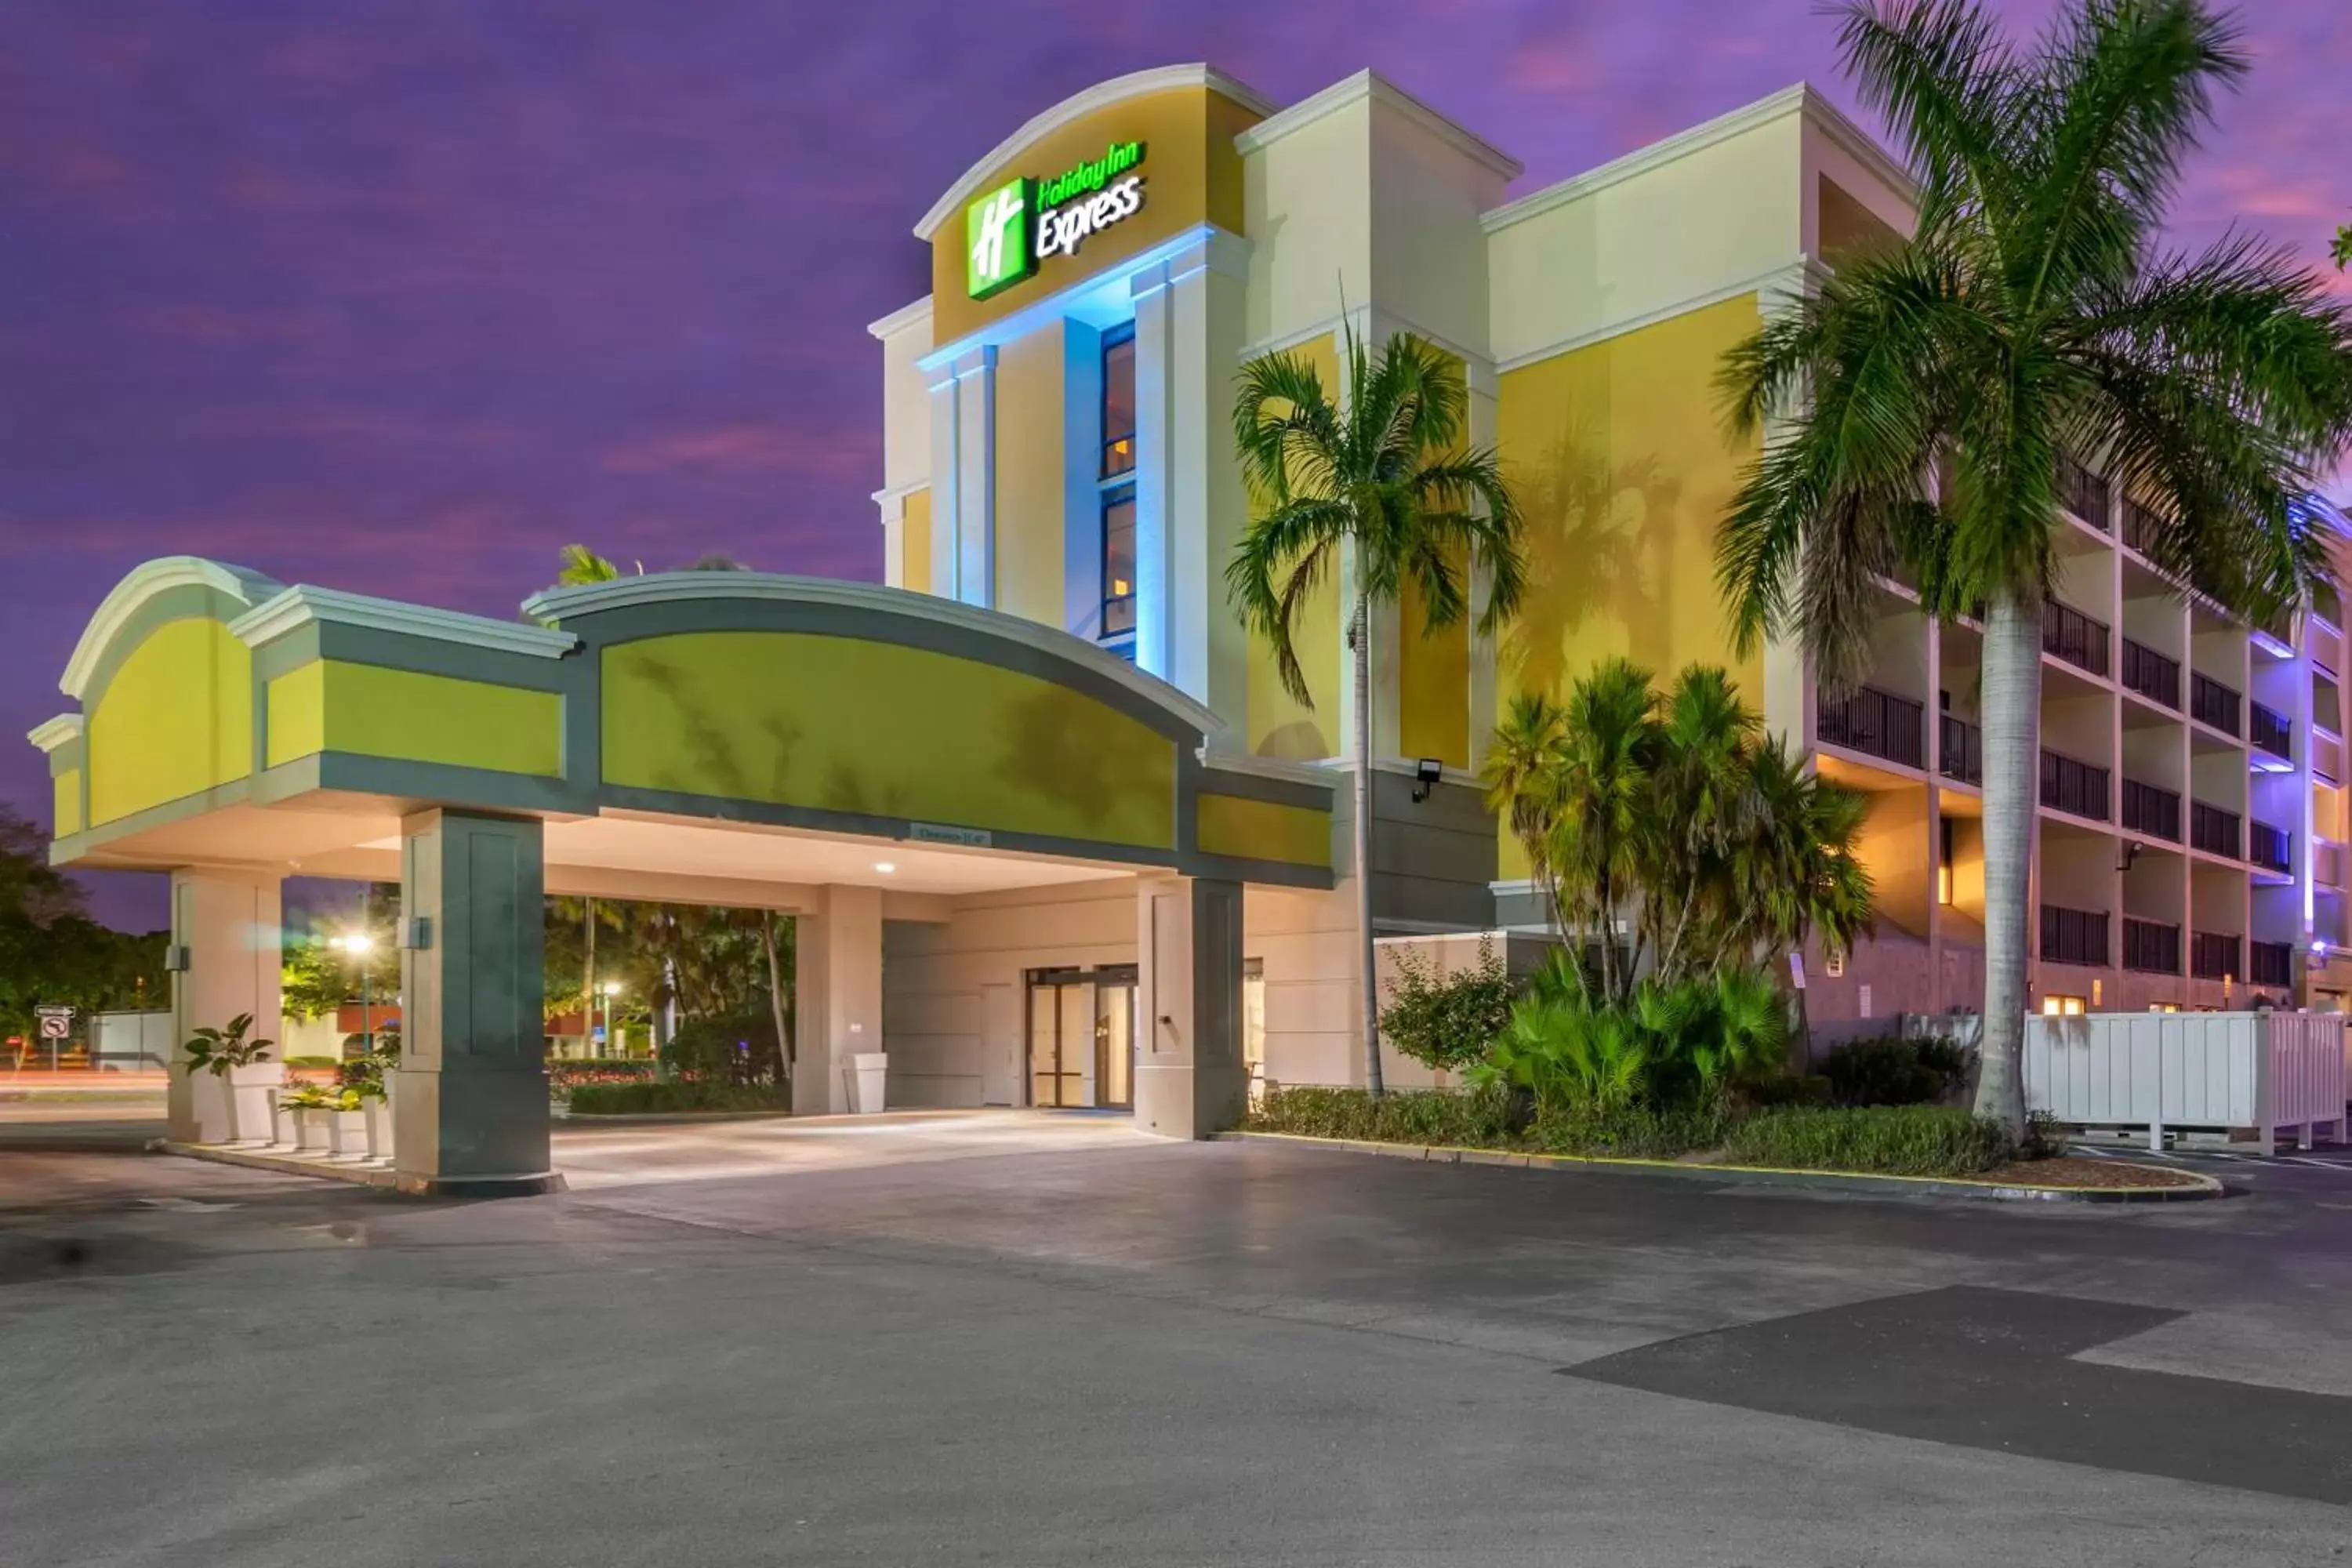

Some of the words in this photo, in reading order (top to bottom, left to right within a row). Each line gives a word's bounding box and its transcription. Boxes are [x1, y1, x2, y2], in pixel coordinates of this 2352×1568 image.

[1036, 159, 1105, 212] Holiday
[1106, 141, 1138, 174] Inn
[1036, 176, 1140, 257] Express
